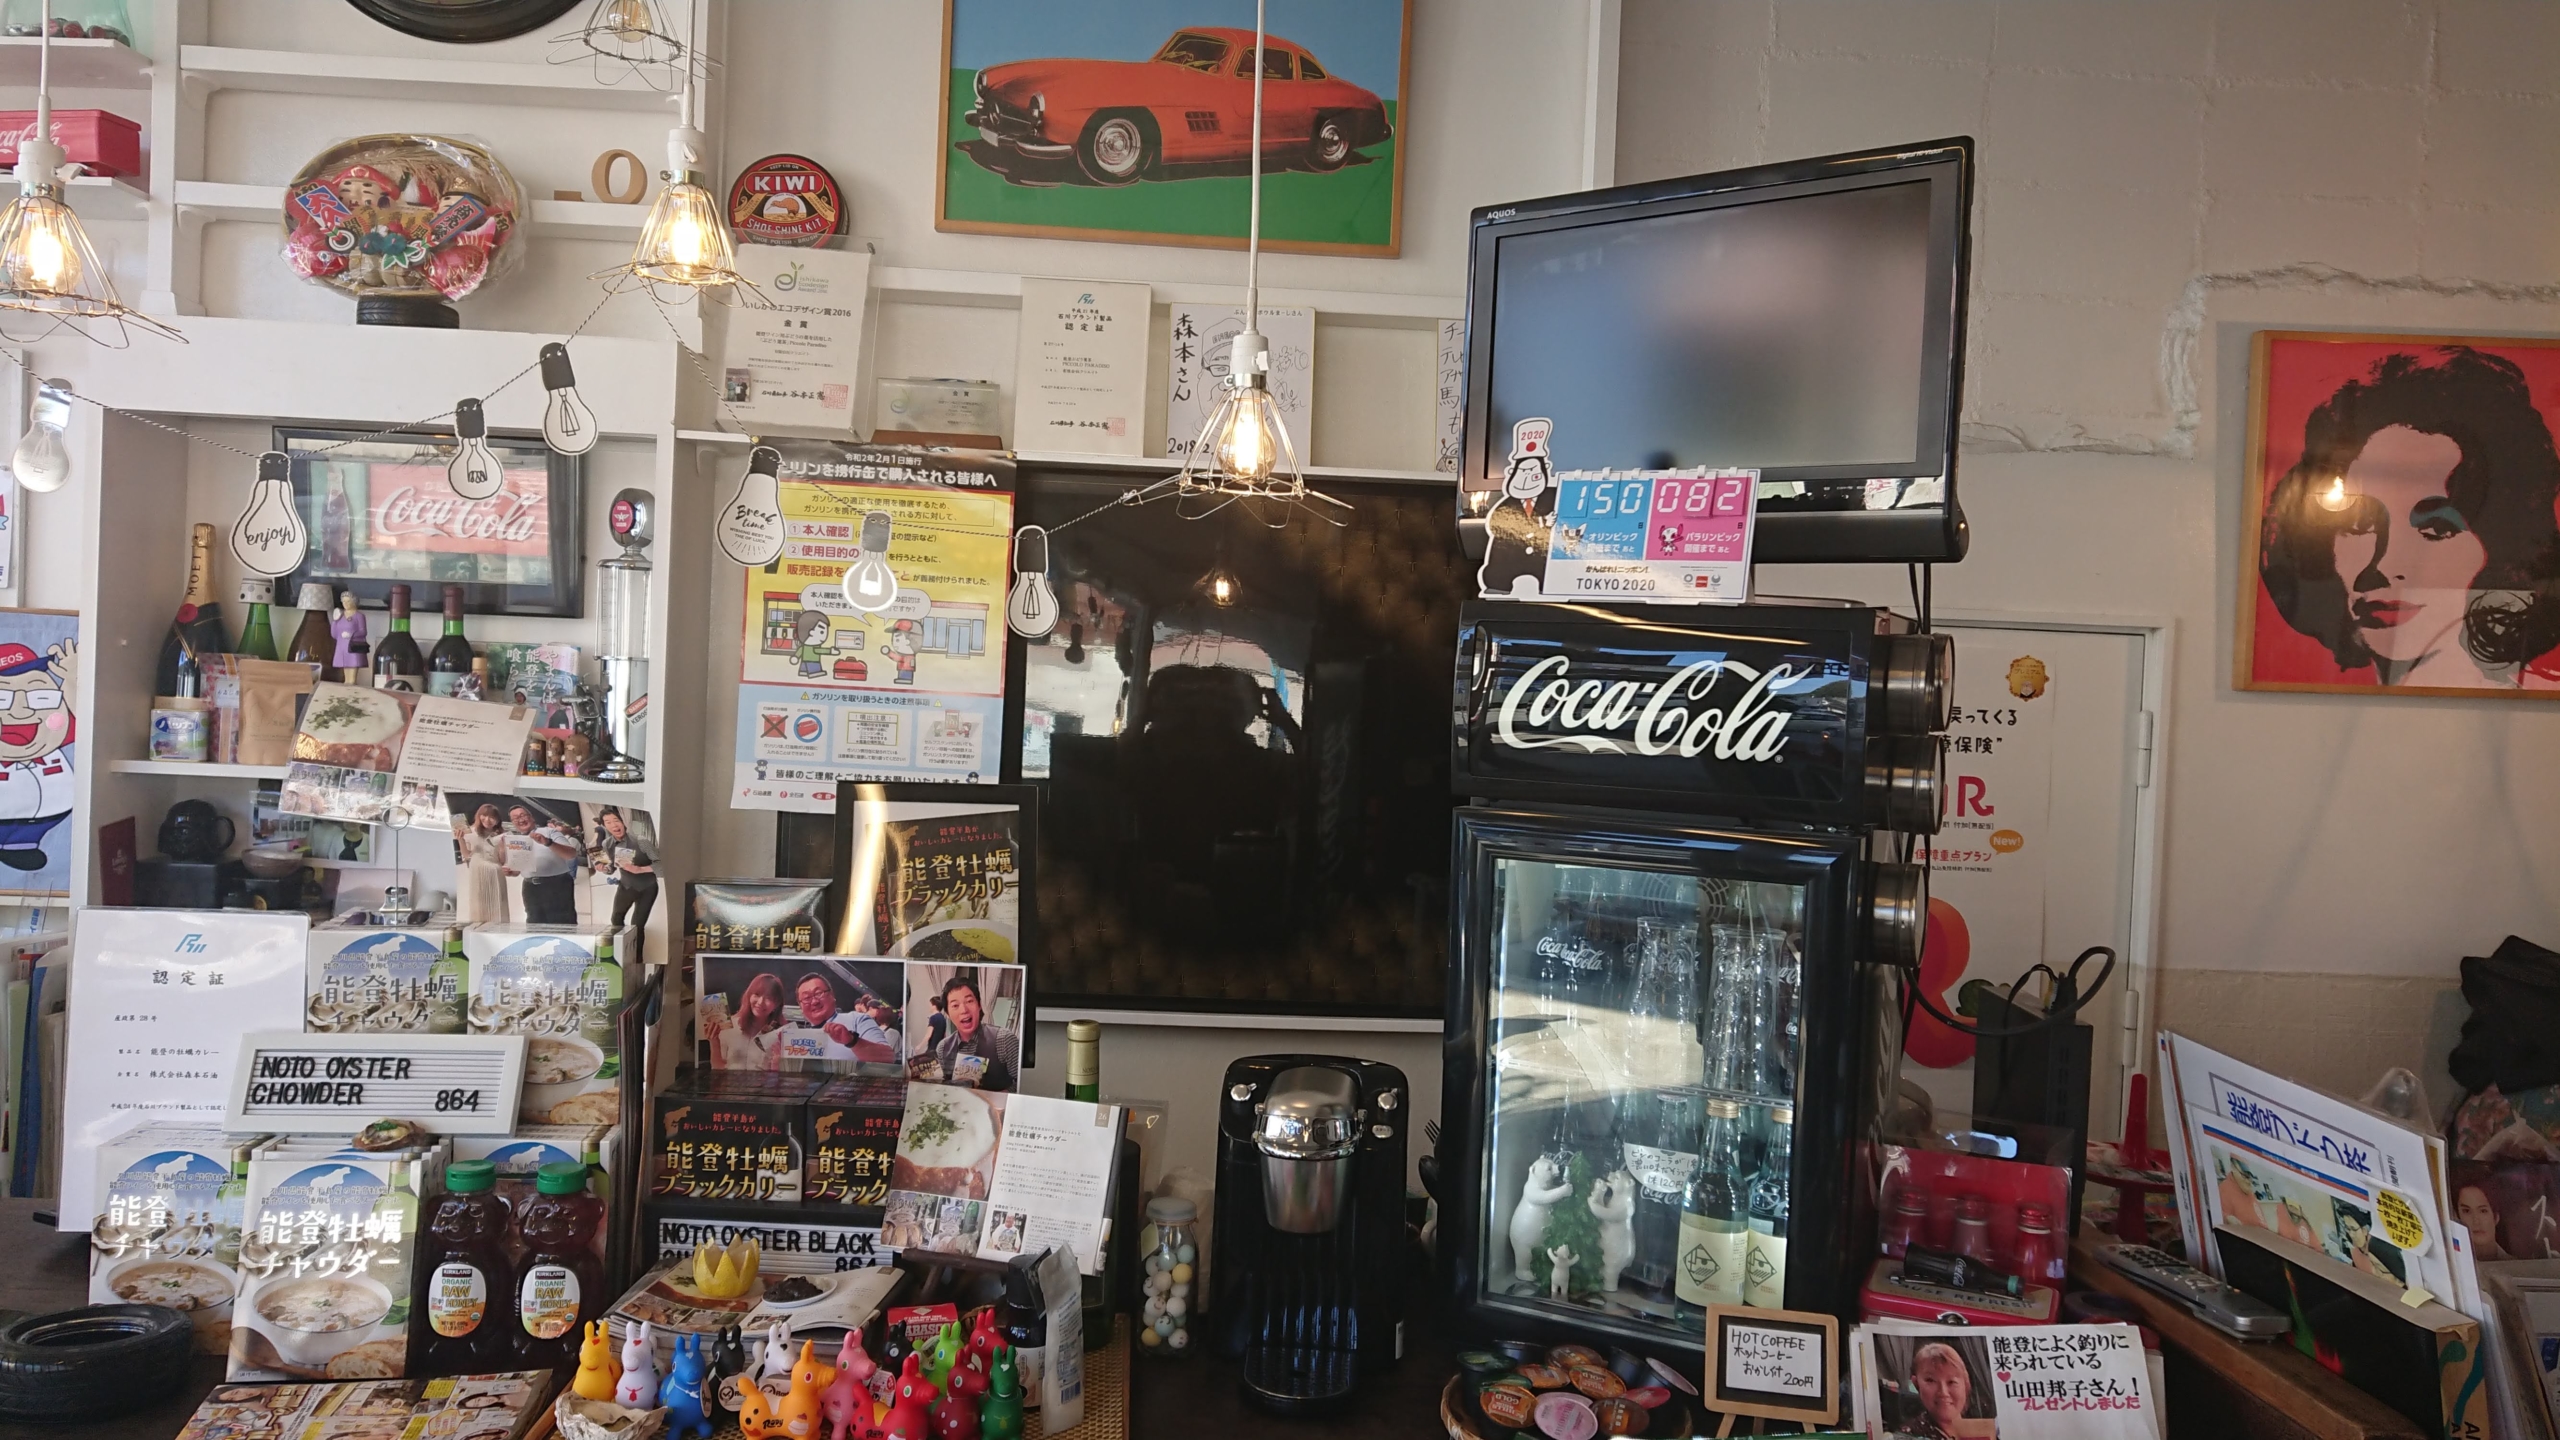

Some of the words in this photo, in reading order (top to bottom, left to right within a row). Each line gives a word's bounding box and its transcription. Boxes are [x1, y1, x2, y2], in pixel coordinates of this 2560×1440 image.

[754, 176, 815, 191] KIWI
[1486, 208, 1516, 219] AQUOS
[746, 218, 772, 234] SHOE
[774, 225, 802, 235] SHINE
[805, 218, 822, 232] KIT
[752, 234, 768, 243] SHOE
[798, 234, 818, 244] BRUSH
[745, 302, 852, 317] いしかわエコデザイン賞2016
[1064, 322, 1105, 332] 認定証
[1173, 313, 1199, 402] 森本さん
[1521, 430, 1544, 440] 2020
[845, 453, 922, 466] 令和2年2月1日施行
[1576, 483, 1644, 514] 150
[1656, 480, 1742, 513] 082
[735, 504, 777, 526] Break
[742, 518, 766, 530] time
[246, 526, 296, 551] enjoy
[1588, 532, 1638, 542] オリンピック
[1685, 532, 1740, 542] パラリンピック
[1684, 544, 1716, 554] 開催まで
[1576, 578, 1618, 590] TOKYO
[1622, 578, 1656, 591] 2020
[525, 649, 541, 692] 能登を
[1498, 655, 1815, 762] Coca-Cola
[940, 826, 979, 836] 能登半島が
[914, 834, 1003, 847] おいしいカレーになりました。
[1993, 836, 2021, 846] New!
[901, 848, 1014, 883] 能登牡蠣
[898, 876, 1019, 906] ブラックカリー
[695, 923, 812, 952] 能登牡蠣
[152, 970, 224, 986] 認定証
[324, 974, 459, 1004] 能登牡蠣
[484, 977, 610, 1007] 能登牡蠣
[327, 1008, 458, 1032] チャウダー
[150, 1071, 218, 1079] 株式会社森本石油
[260, 1056, 316, 1078] NOTO
[326, 1056, 411, 1080] OYSTER
[252, 1082, 364, 1105] CHOWDER
[435, 1088, 480, 1112] 864
[110, 1102, 227, 1111] 平成24年度石川ブランド製品として認定し
[712, 1112, 757, 1123] 能登半島が
[864, 1118, 900, 1128] 能登半島
[682, 1122, 783, 1135] おいしいカレーになりました。
[1008, 1130, 1068, 1142] 能登牡蠣チャウダー
[666, 1141, 789, 1174] 能登牡蠣
[659, 1174, 796, 1199] ブラックカリー
[812, 1178, 888, 1201] ブラック
[259, 1209, 404, 1246] 能登牡蠣
[662, 1222, 716, 1246] NOTO
[808, 1230, 876, 1256] BLACK
[2392, 1232, 2412, 1248] います。
[259, 1250, 400, 1280] チャウダー
[442, 1286, 471, 1298] RAW
[536, 1287, 565, 1298] RAW
[446, 1298, 478, 1308] HONEY
[540, 1298, 572, 1309] HONEY
[1732, 1328, 1759, 1348] HOT
[1760, 1334, 1806, 1351] COFFEE
[1992, 1334, 2130, 1354] 能登によく釣りに
[1733, 1346, 1793, 1360] ホットコーヒー
[1994, 1354, 2102, 1372] 来られている
[1742, 1360, 1783, 1378] おかし付
[1782, 1372, 1814, 1388] 200円
[2006, 1378, 2140, 1398] 山田邦子さん！
[1495, 1392, 1520, 1405] GOLD
[2017, 1396, 2141, 1411] プレゼントしました
[762, 1418, 784, 1430] Rody
